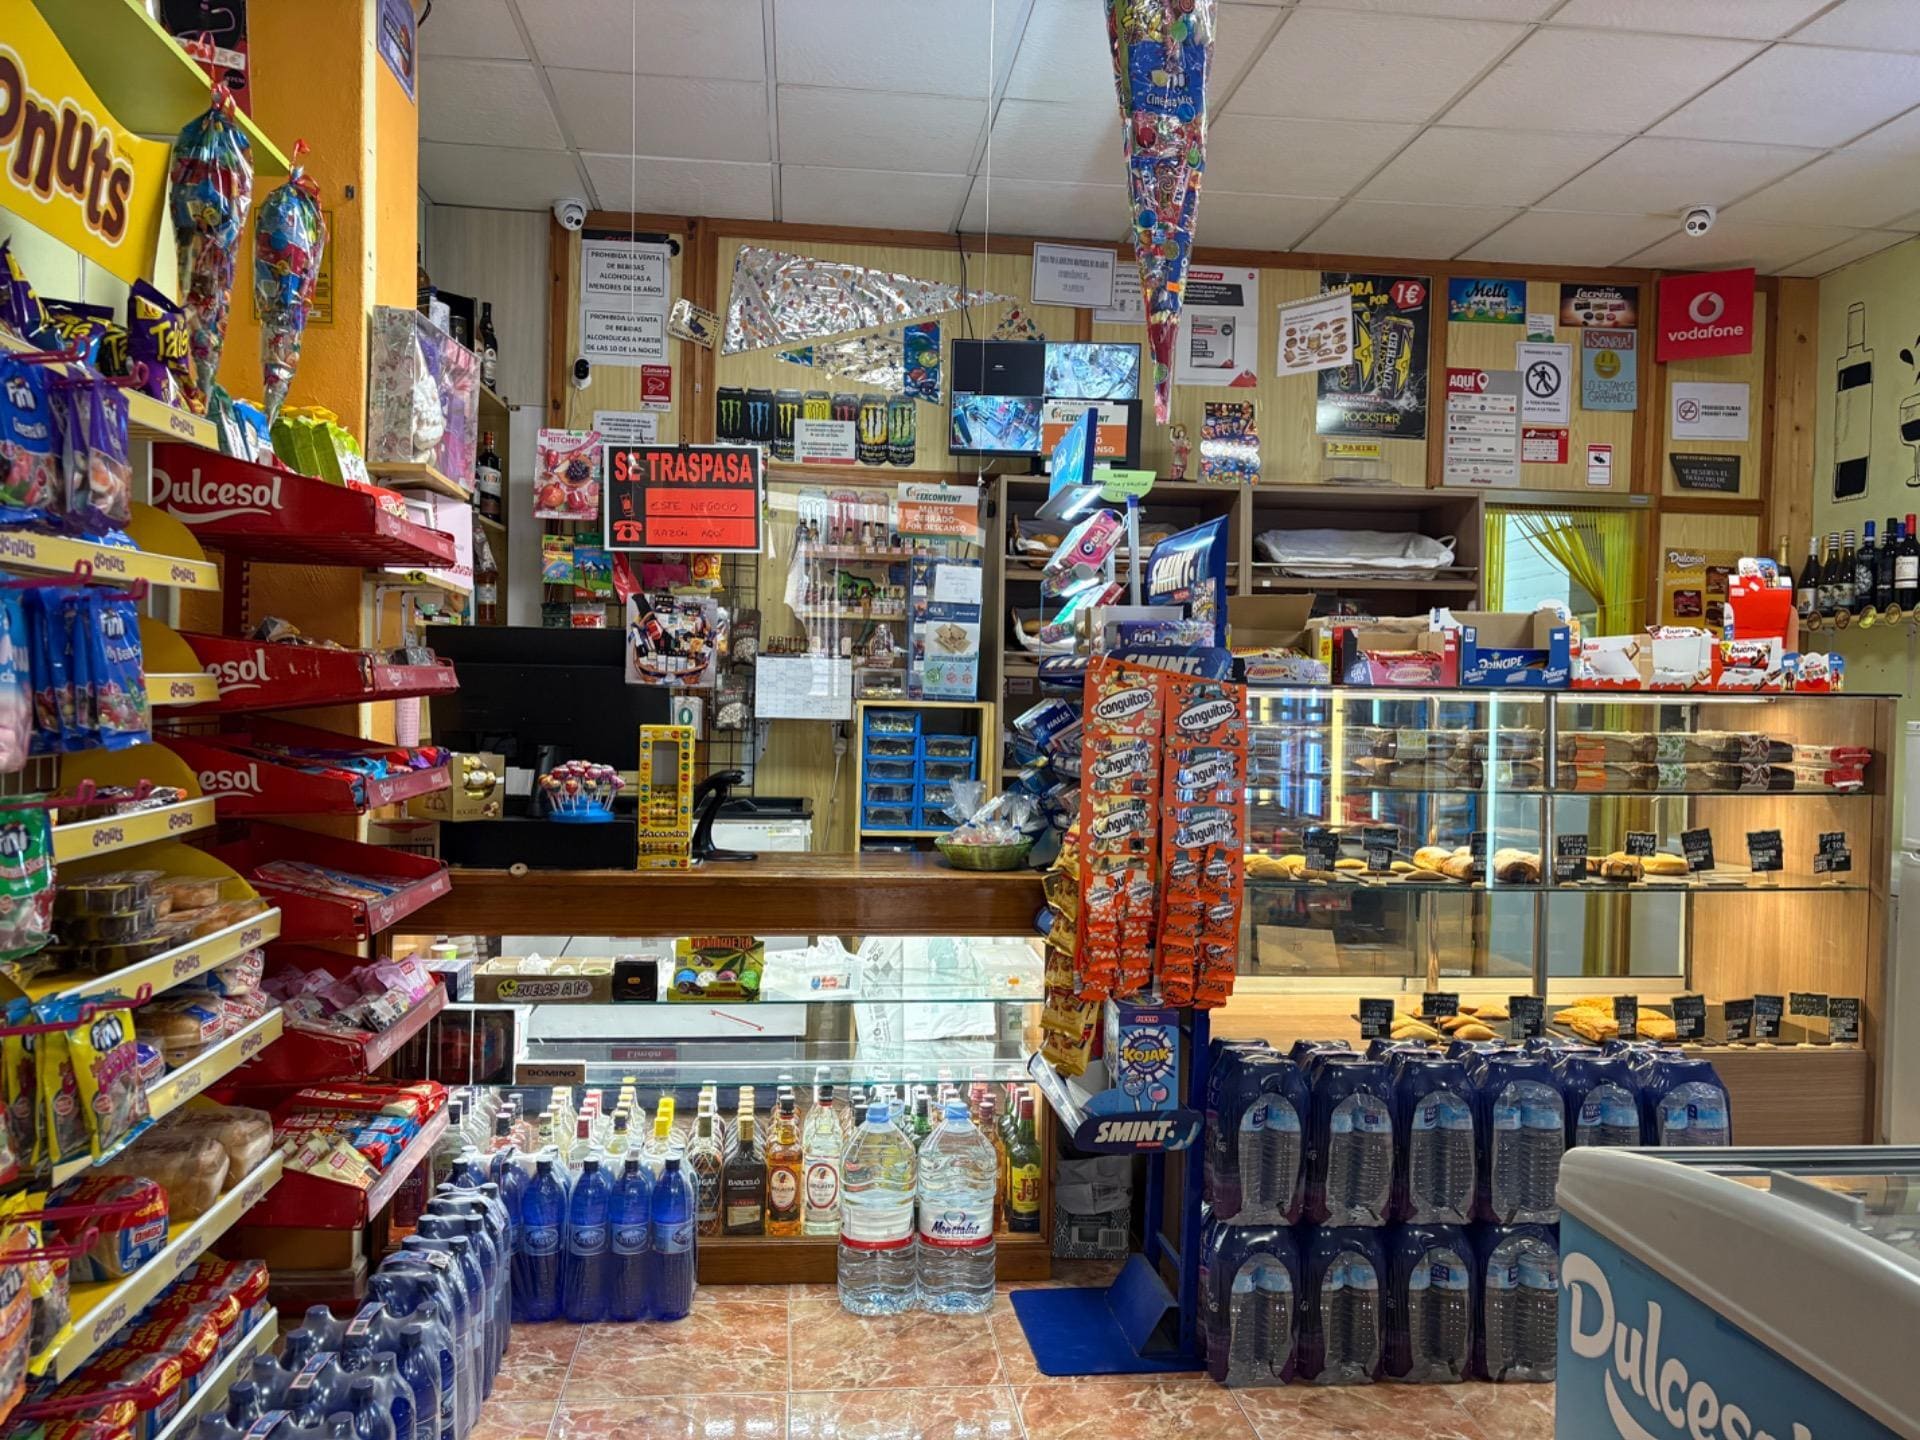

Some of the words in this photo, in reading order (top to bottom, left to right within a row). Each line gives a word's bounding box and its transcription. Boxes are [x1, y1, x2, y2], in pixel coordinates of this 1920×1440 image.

[591, 251, 627, 259] PROHIBIDA
[589, 282, 621, 290] MENORES
[1370, 295, 1390, 306] POR
[1397, 285, 1420, 303] 1€
[590, 314, 626, 322] PROHIBIDA
[1668, 325, 1744, 342] vodafone
[1382, 331, 1399, 390] PUNCHED
[1449, 371, 1475, 387] AQUÍ
[1342, 443, 1377, 452] PANINI
[649, 452, 753, 483] TRASPASA
[151, 467, 283, 511] Dulcesol
[651, 502, 681, 512] ESTE
[690, 502, 739, 513] NEGOCIO
[919, 505, 954, 514] MARTES
[914, 514, 955, 523] CERRADO
[906, 522, 922, 531] POR
[925, 523, 966, 533] DESCANSO
[1731, 646, 1757, 655] bueno
[1099, 690, 1150, 715] conguitos
[1180, 701, 1234, 727] conguitos
[199, 763, 263, 793] esol
[1123, 1047, 1171, 1063] KOJAK
[527, 1069, 577, 1078] DOMINO
[1093, 1120, 1172, 1144] SMINT
